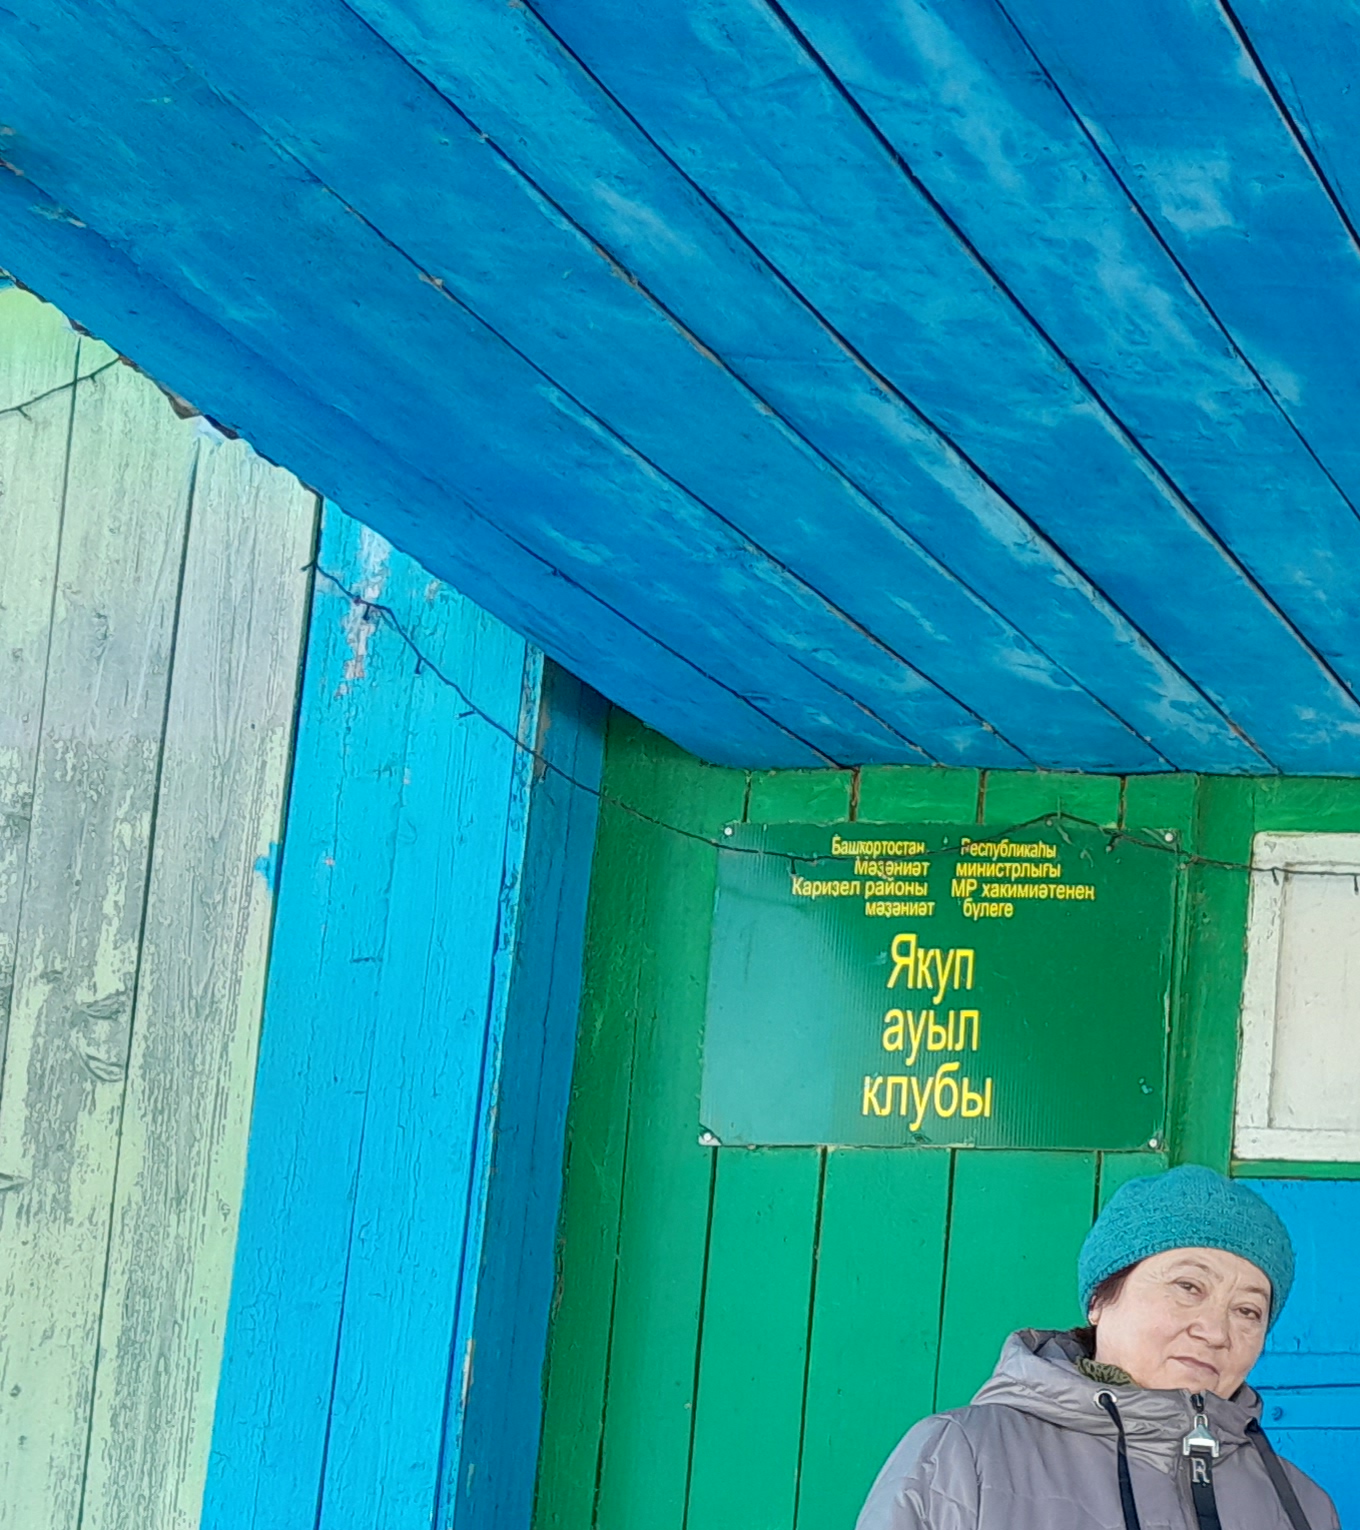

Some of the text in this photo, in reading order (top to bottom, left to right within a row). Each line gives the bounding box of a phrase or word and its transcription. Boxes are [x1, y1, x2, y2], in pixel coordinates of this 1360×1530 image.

[864, 877, 928, 899] районы
[951, 878, 977, 897] МР
[882, 1008, 979, 1065] ауыл
[861, 1062, 993, 1131] клубы
